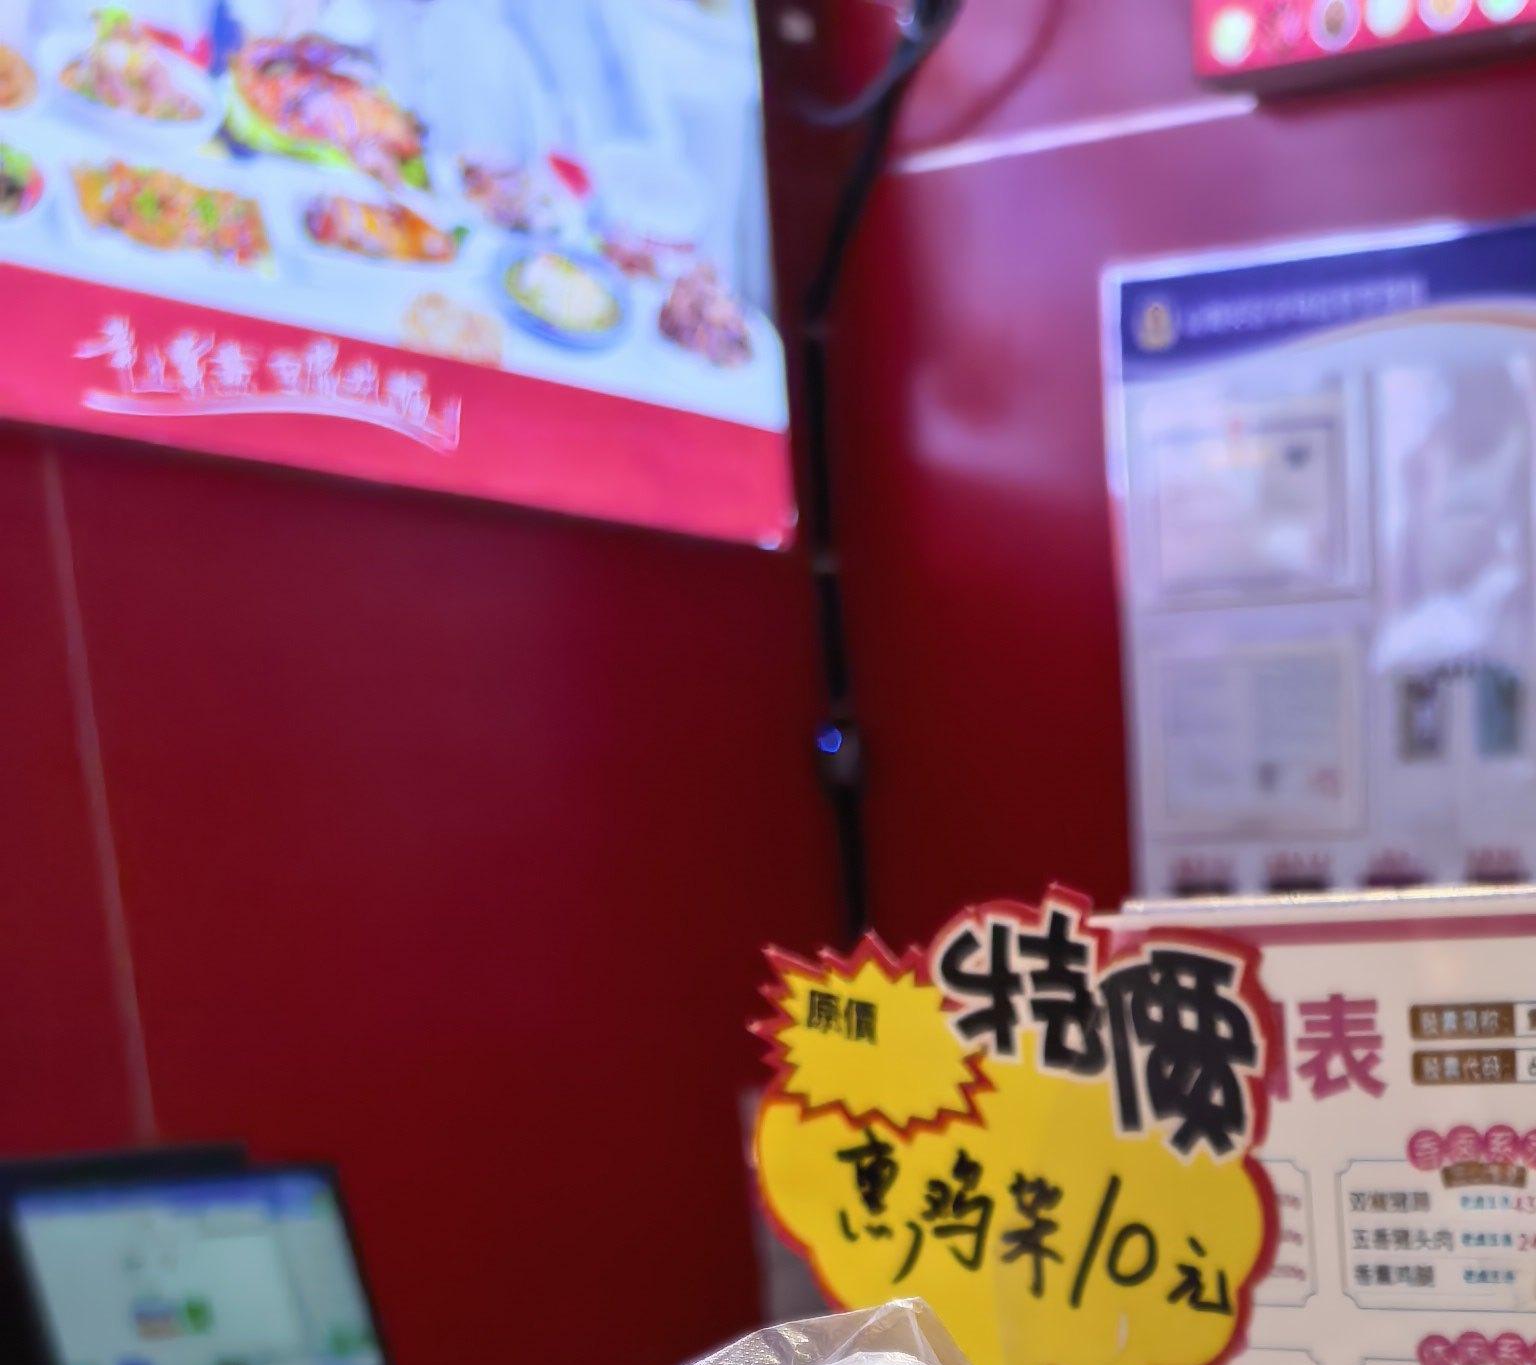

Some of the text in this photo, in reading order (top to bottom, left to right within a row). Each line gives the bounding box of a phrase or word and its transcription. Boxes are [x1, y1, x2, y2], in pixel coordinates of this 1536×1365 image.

[807, 990, 878, 1044] 原價
[940, 911, 1258, 1155] 特價
[1270, 994, 1388, 1100] 表
